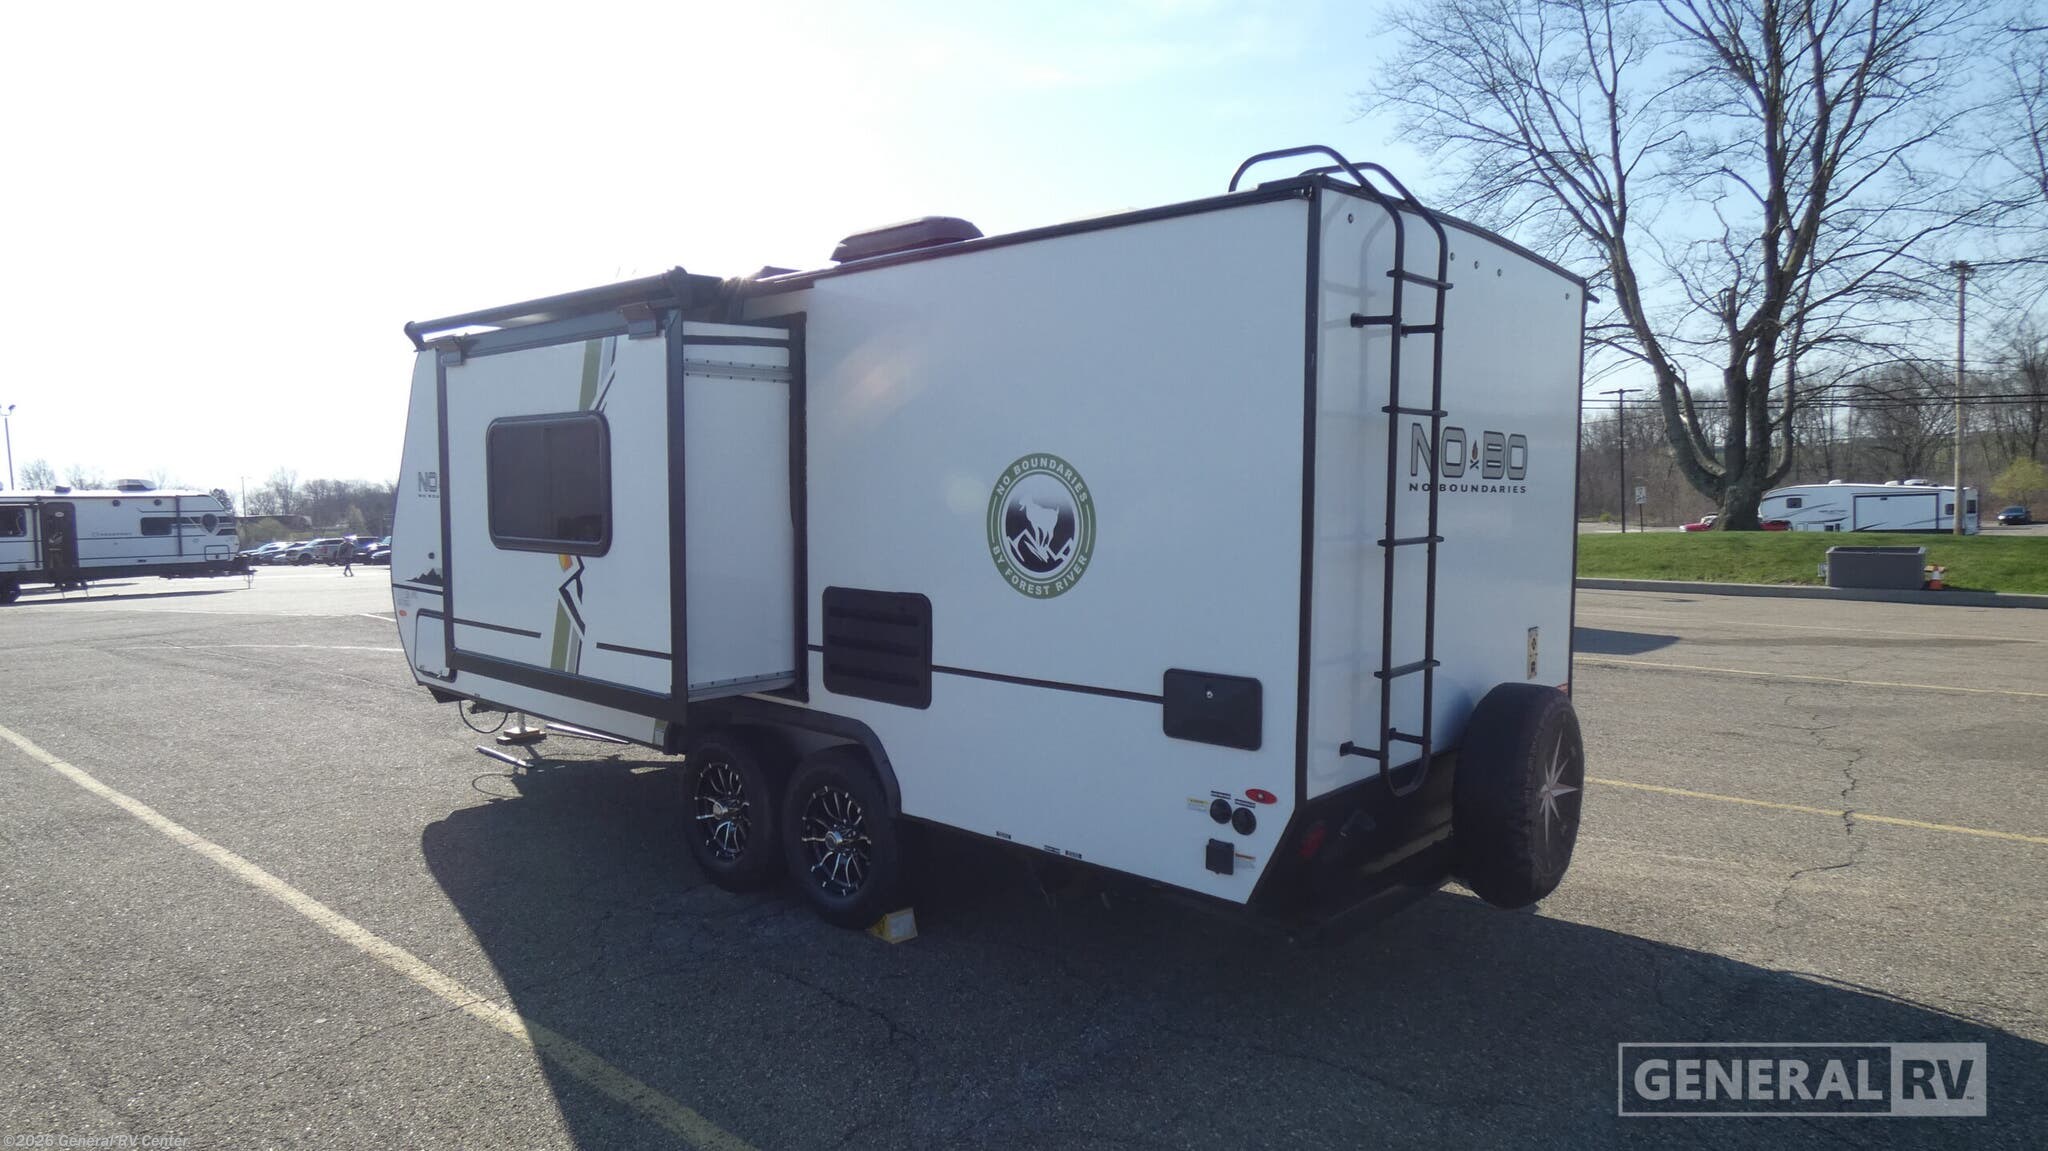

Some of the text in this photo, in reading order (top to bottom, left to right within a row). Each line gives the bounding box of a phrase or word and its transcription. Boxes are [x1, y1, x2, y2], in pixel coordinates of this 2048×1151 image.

[996, 457, 1088, 502] NO BOUNDARIES
[1409, 483, 1526, 494] NO BOUNDARIES
[992, 545, 1087, 595] BY FOREST RIVER
